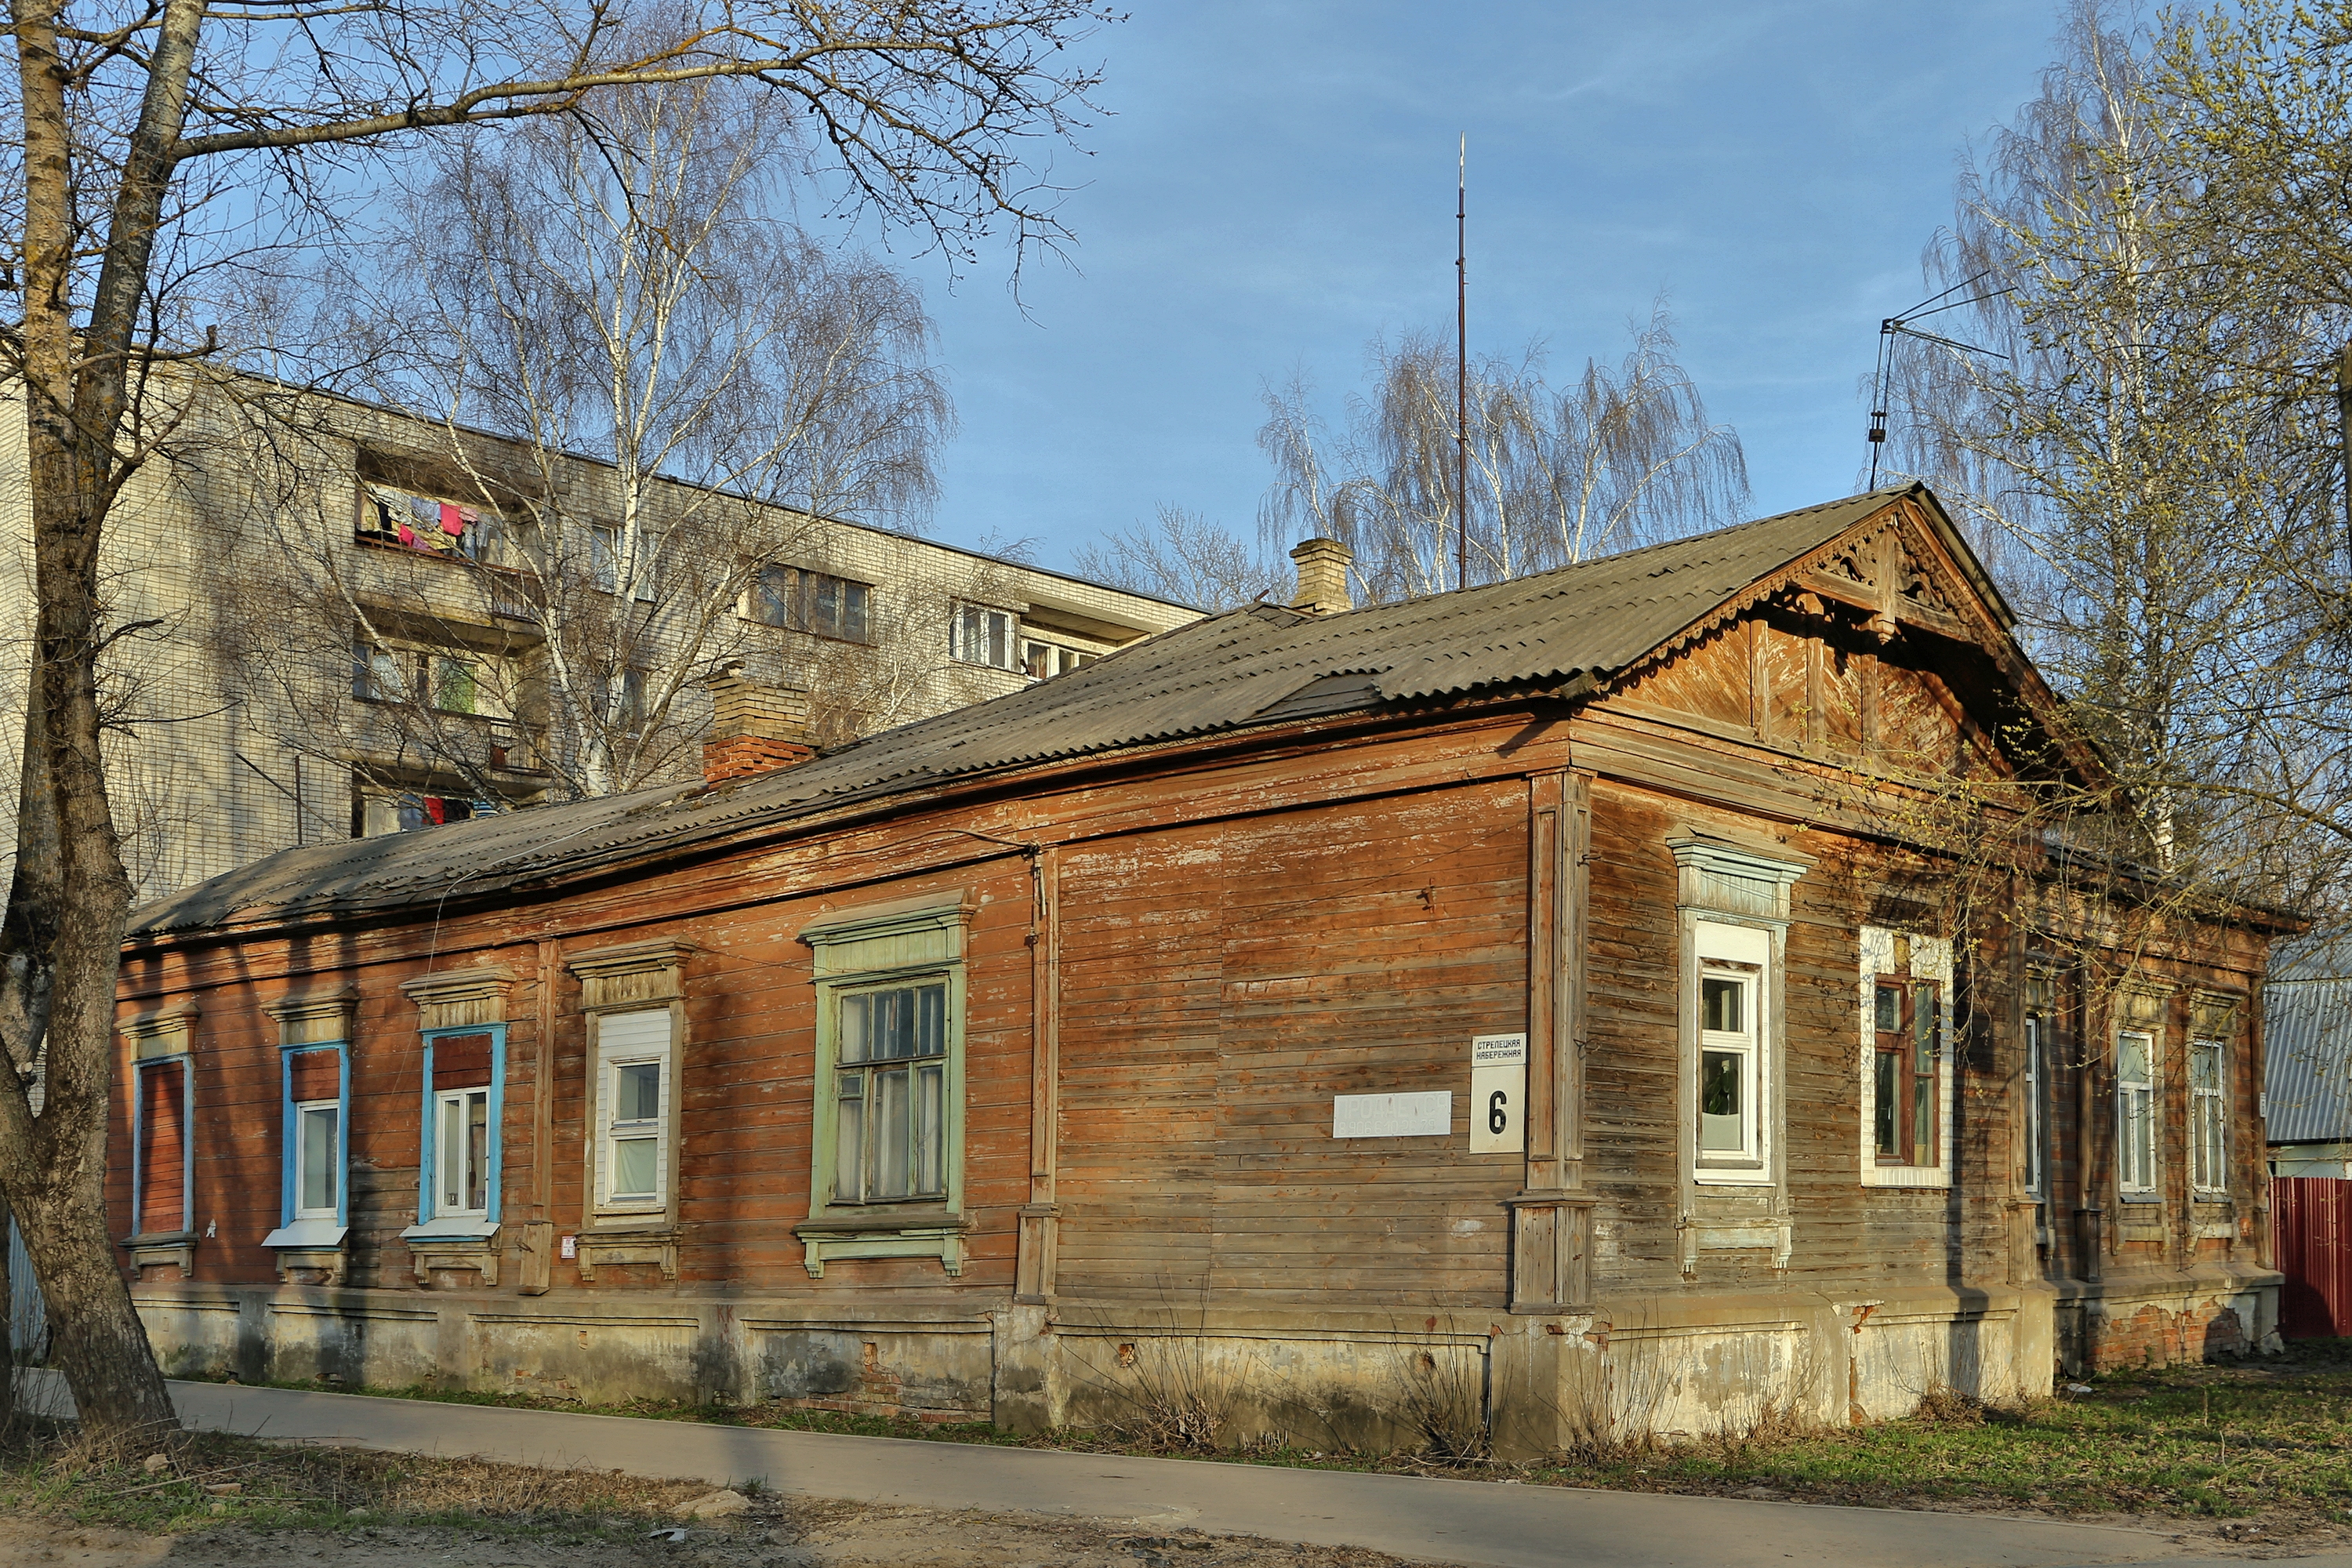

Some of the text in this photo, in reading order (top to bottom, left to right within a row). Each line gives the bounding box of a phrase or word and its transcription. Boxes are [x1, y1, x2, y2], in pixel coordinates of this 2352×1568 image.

[1477, 1039, 1520, 1050] СТРЕЛЕЦКАЯ
[1476, 1049, 1521, 1060] НАБЕРЕЖНАЯ
[1490, 1091, 1506, 1134] 6
